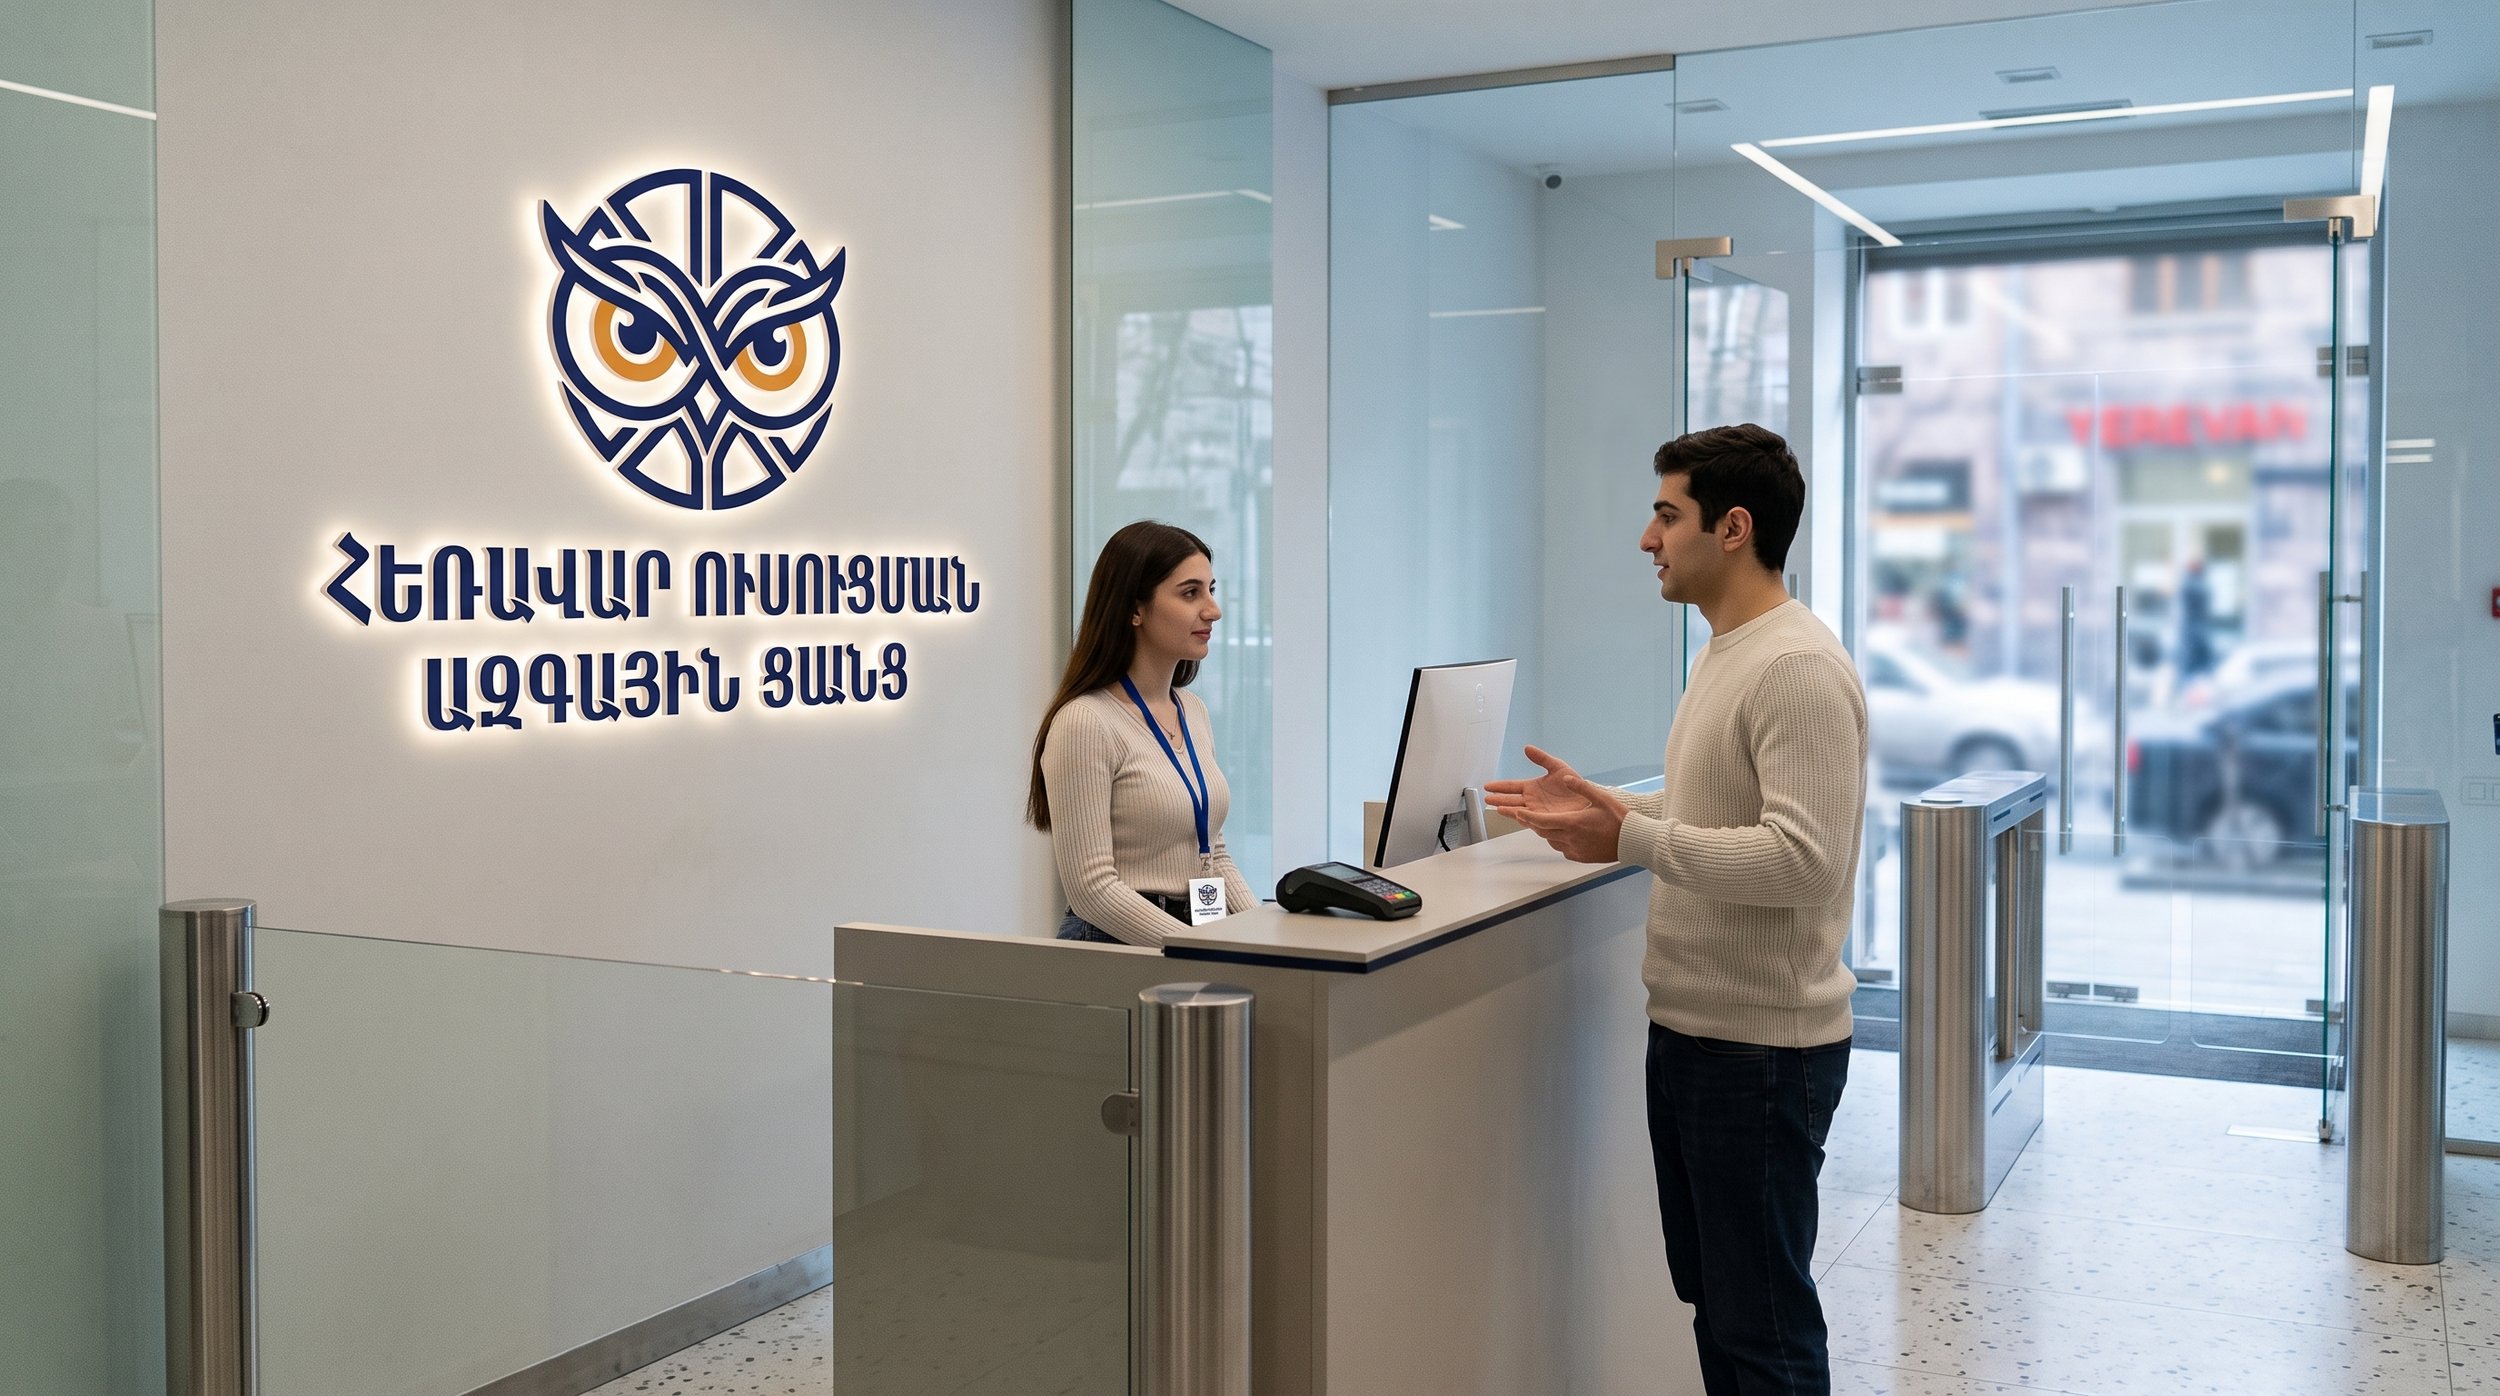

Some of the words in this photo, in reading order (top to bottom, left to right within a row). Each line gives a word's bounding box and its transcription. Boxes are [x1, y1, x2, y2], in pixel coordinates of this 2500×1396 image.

[323, 531, 671, 626] ՀԵՌԱՎԱՐ
[693, 551, 980, 617] ՈՒՍՈՒՑՄԱՆ
[425, 647, 740, 731] ԱԶԳԱՅԻՆ
[761, 642, 909, 709] ՑԱՆՑ
